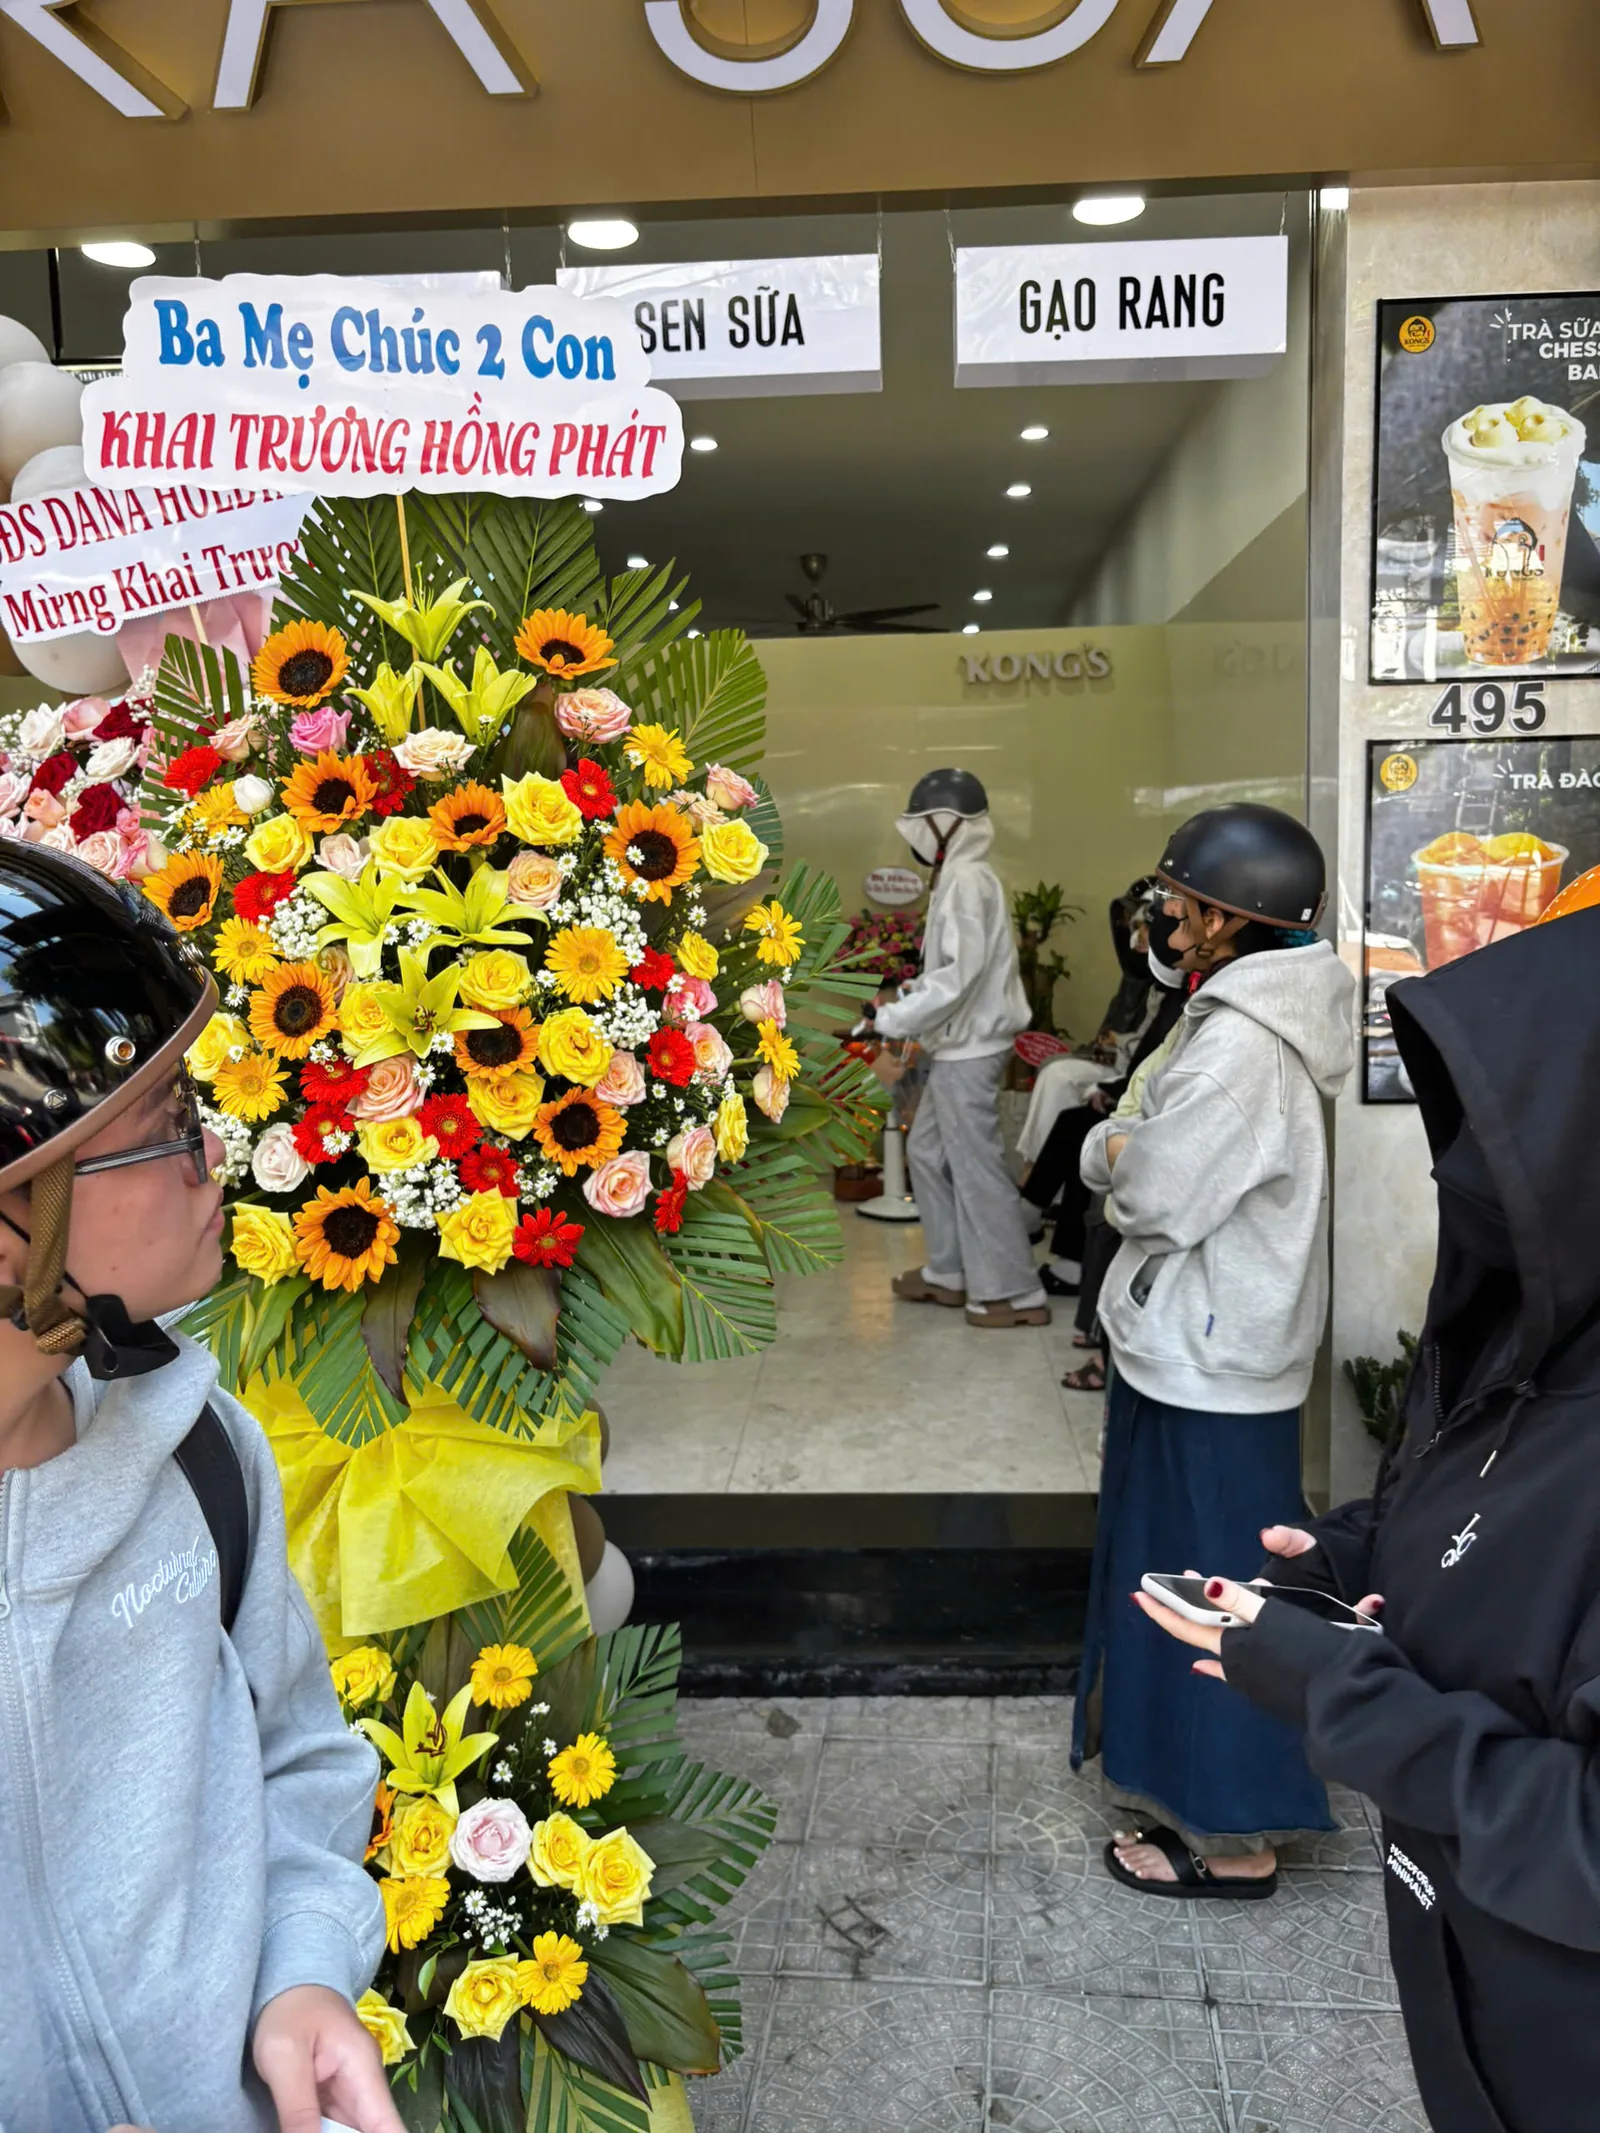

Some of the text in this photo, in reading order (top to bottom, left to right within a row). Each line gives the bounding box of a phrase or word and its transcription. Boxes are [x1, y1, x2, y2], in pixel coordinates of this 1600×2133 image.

[634, 285, 805, 355] SEN SỮA
[1020, 272, 1225, 341] GẠO RANG
[1508, 317, 1600, 340] TRÀ SỮA
[153, 299, 617, 389] Ba Mẹ Chúc 2 Con
[1538, 341, 1600, 359] CHES
[1568, 364, 1600, 381] BA
[100, 391, 667, 478] KHAI TRƯƠNG HỒNG PHÁT
[0, 503, 47, 565] ĐS
[42, 486, 153, 552] DANA
[4, 583, 117, 639] Mừng
[112, 552, 203, 613] Khai
[961, 641, 1111, 684] KONG'S
[1429, 681, 1547, 735] 495
[1509, 769, 1554, 790] TRÀ
